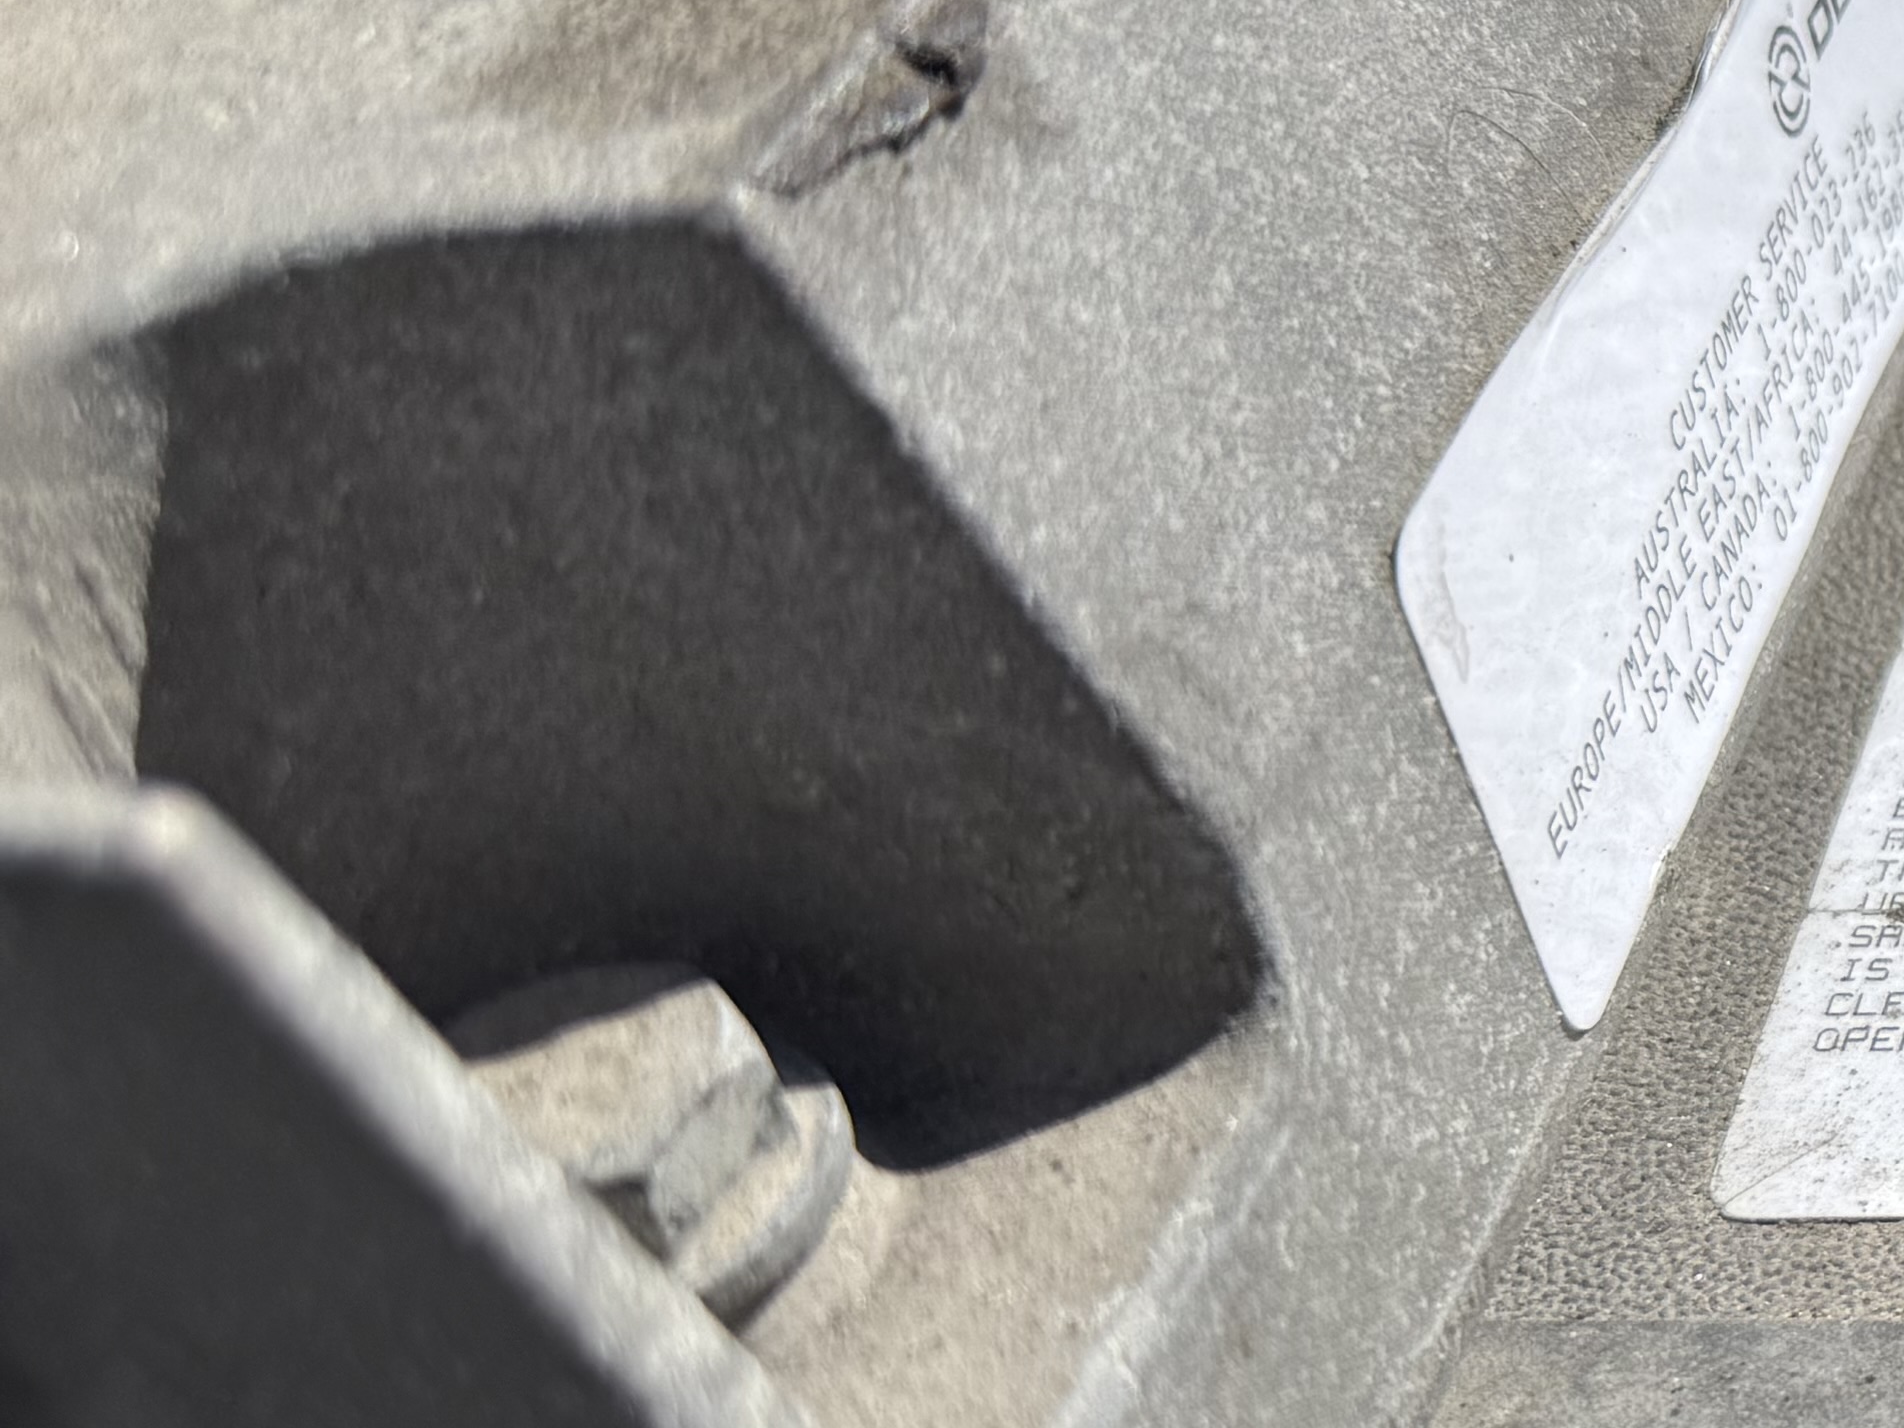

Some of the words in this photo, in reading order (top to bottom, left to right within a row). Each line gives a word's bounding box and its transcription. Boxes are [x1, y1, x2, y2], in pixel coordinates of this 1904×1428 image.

[1669, 274, 1759, 452] CUSTOMER
[1759, 134, 1829, 282] SERVICE
[1546, 534, 1696, 859] EUROPE/MIDDLE
[1699, 297, 1821, 543] EAST/AFRICA:
[1633, 378, 1747, 599] AUSTRALIA:
[1640, 651, 1682, 734] USA
[1683, 611, 1693, 652] /
[1701, 459, 1778, 613] CANADA:
[1683, 565, 1763, 725] MEXICO:
[1839, 958, 1893, 983] IS
